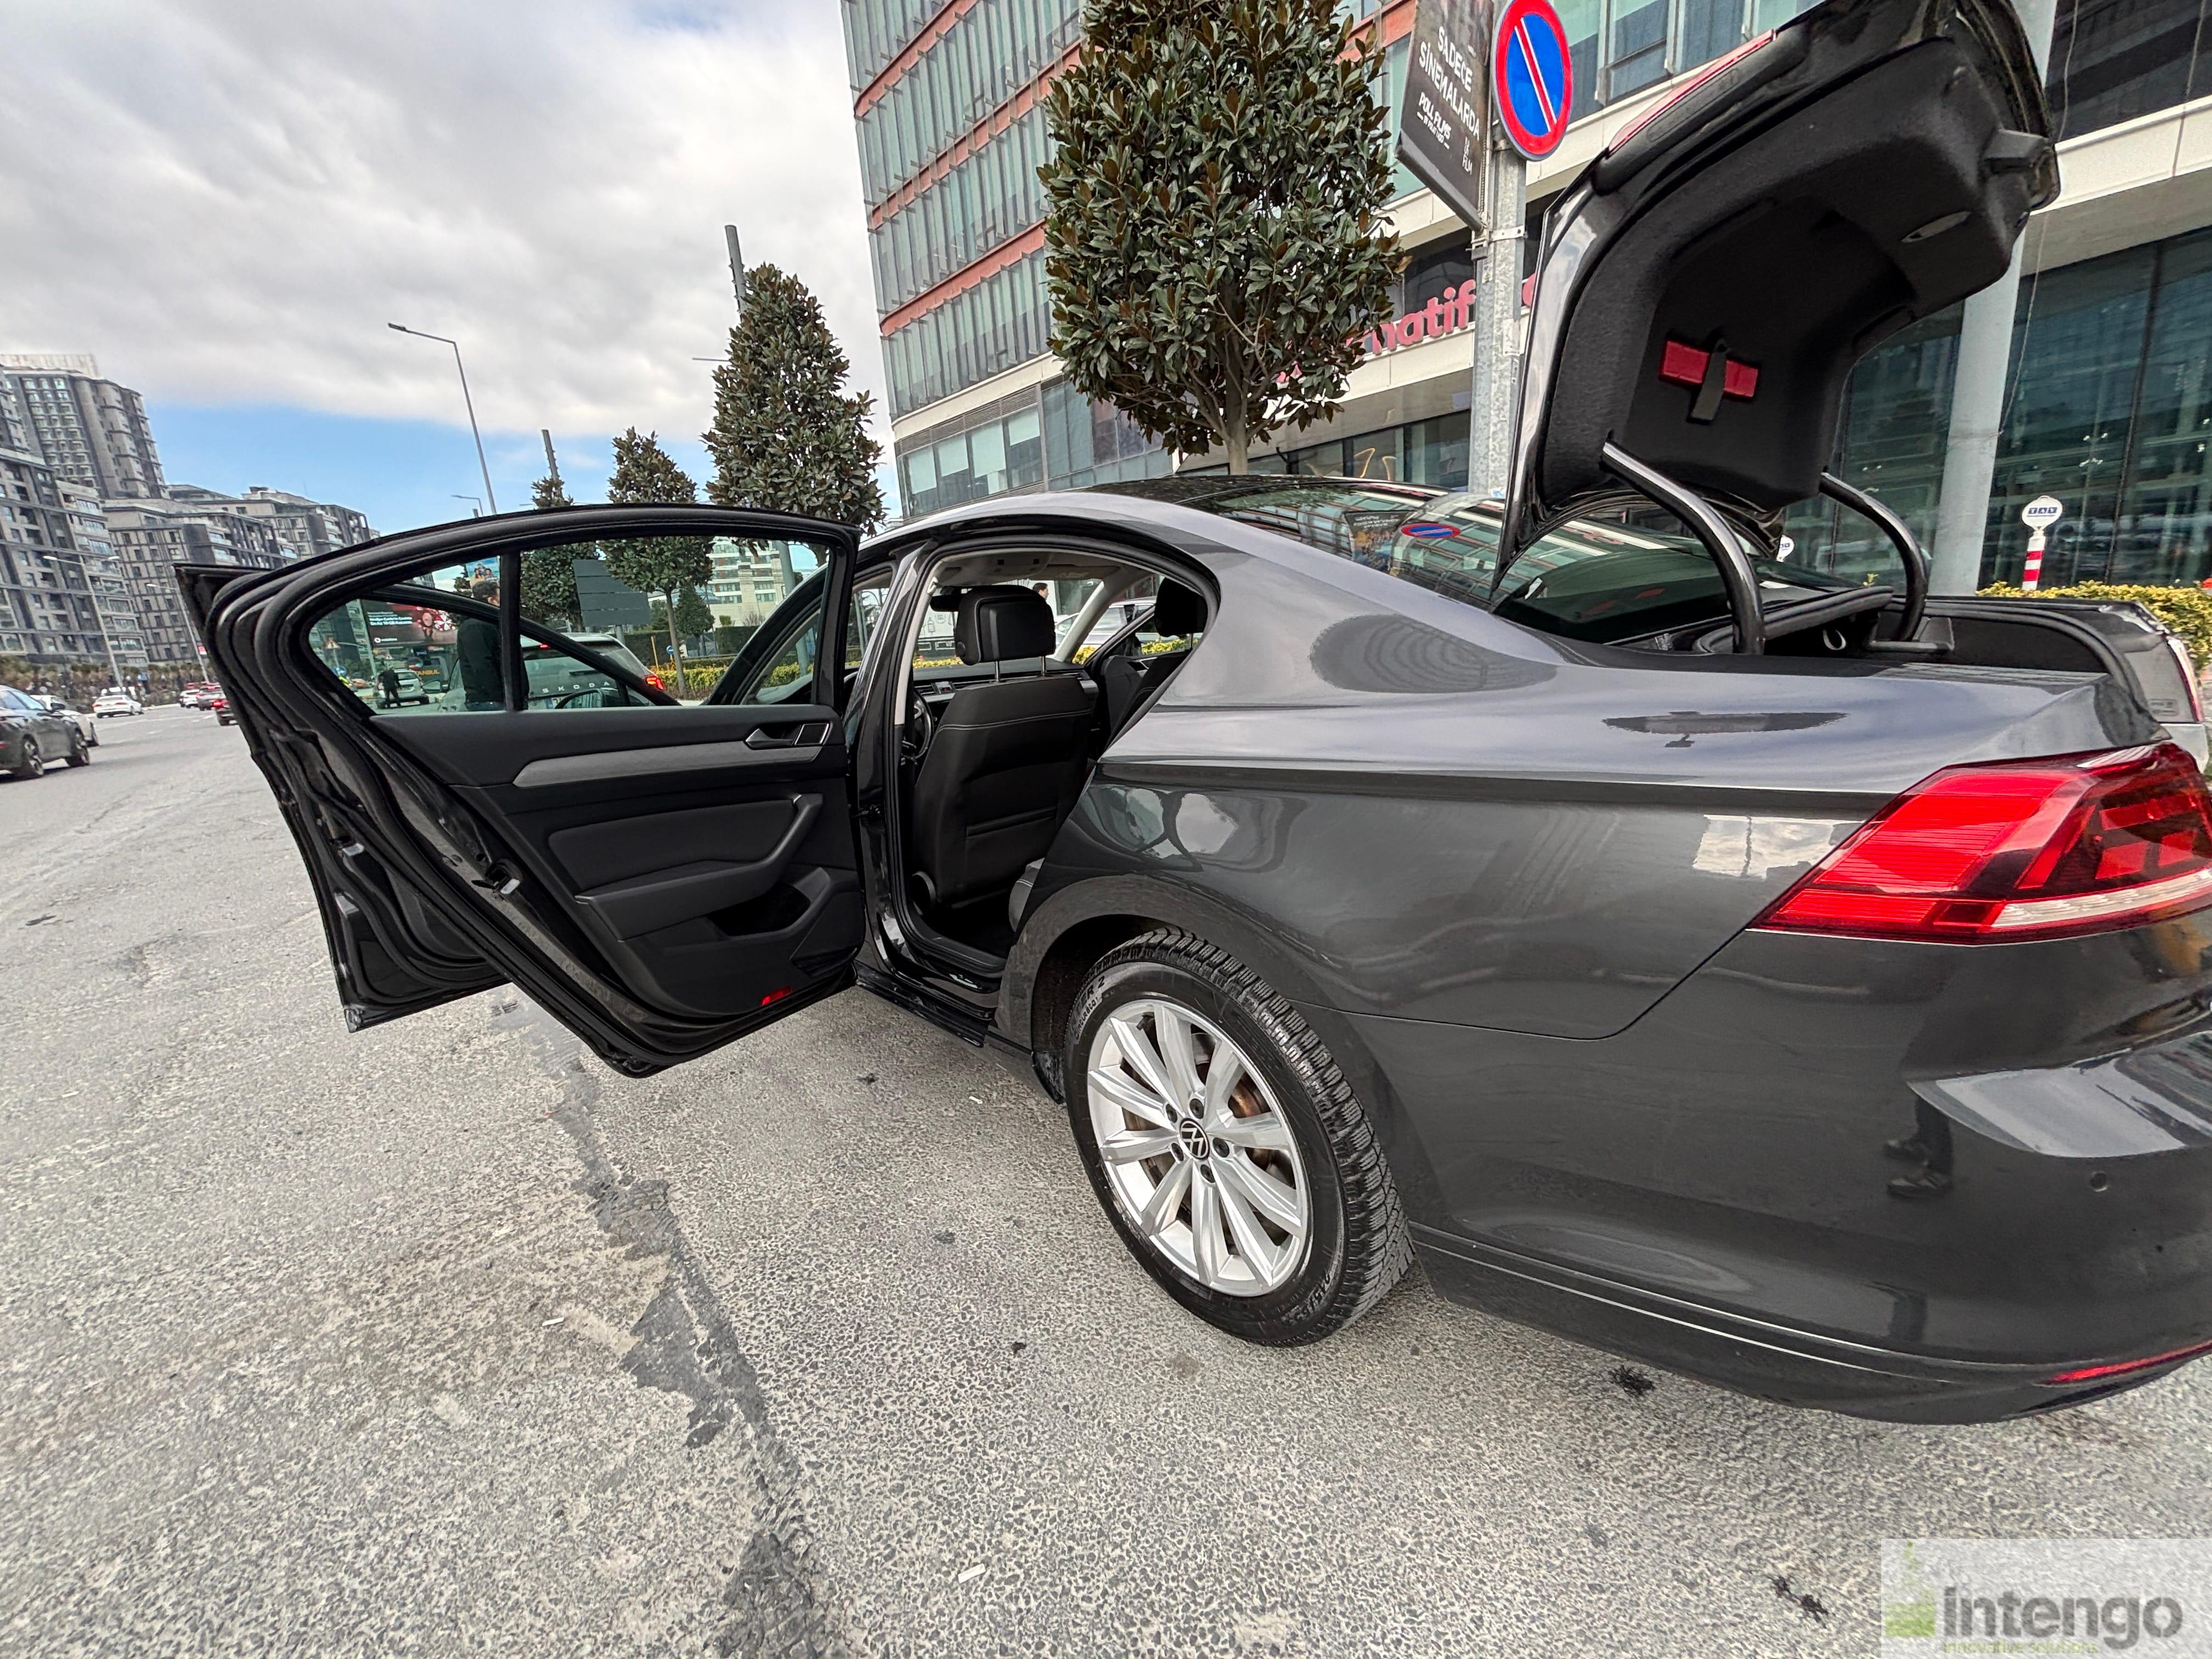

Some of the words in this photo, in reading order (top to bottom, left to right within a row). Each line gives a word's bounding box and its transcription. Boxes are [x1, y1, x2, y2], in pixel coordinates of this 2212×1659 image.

[1419, 41, 1480, 141] SİNEMALARDA
[1438, 26, 1473, 92] SADECE
[1419, 92, 1434, 120] POLL
